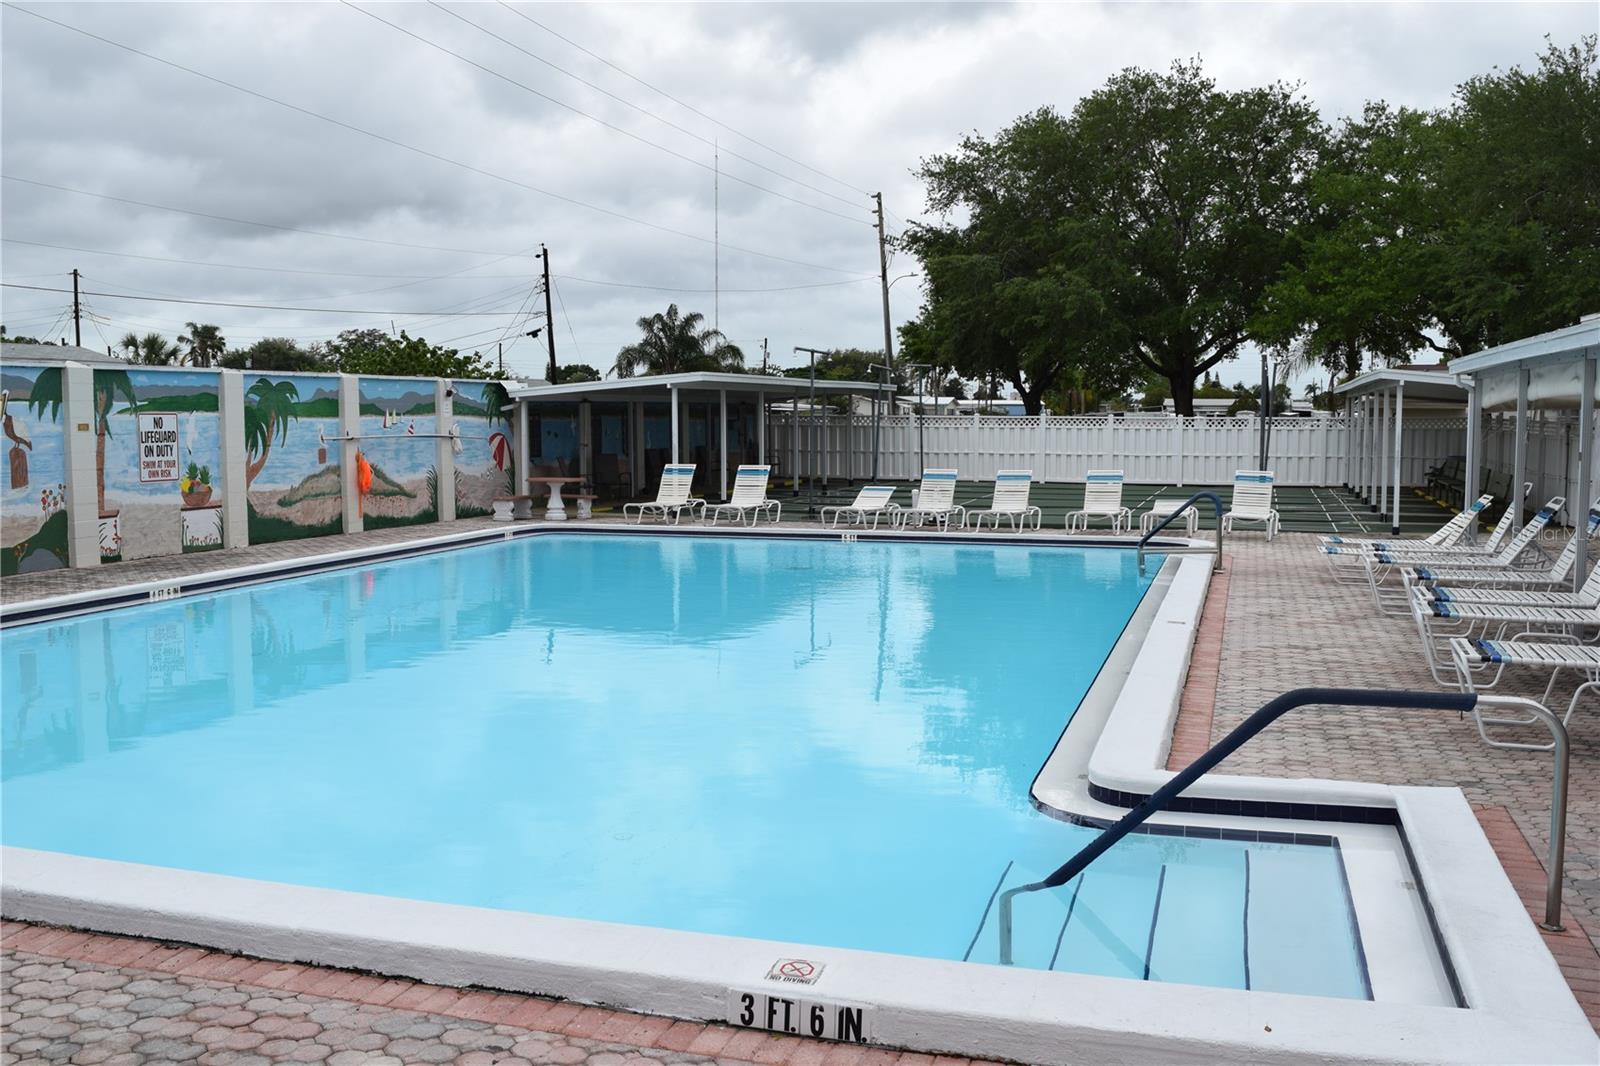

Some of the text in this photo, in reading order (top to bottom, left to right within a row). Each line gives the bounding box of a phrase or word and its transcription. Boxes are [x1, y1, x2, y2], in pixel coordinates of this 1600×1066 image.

[153, 416, 163, 429] NO
[140, 430, 177, 444] LIFEGUARD
[144, 445, 174, 458] ON DUTY
[142, 460, 156, 470] SWIM
[164, 460, 177, 469] YOUR
[148, 469, 172, 478] OWN RISK
[783, 977, 811, 985] DIVING
[740, 993, 868, 1044] 3 FT. 6 IN.
